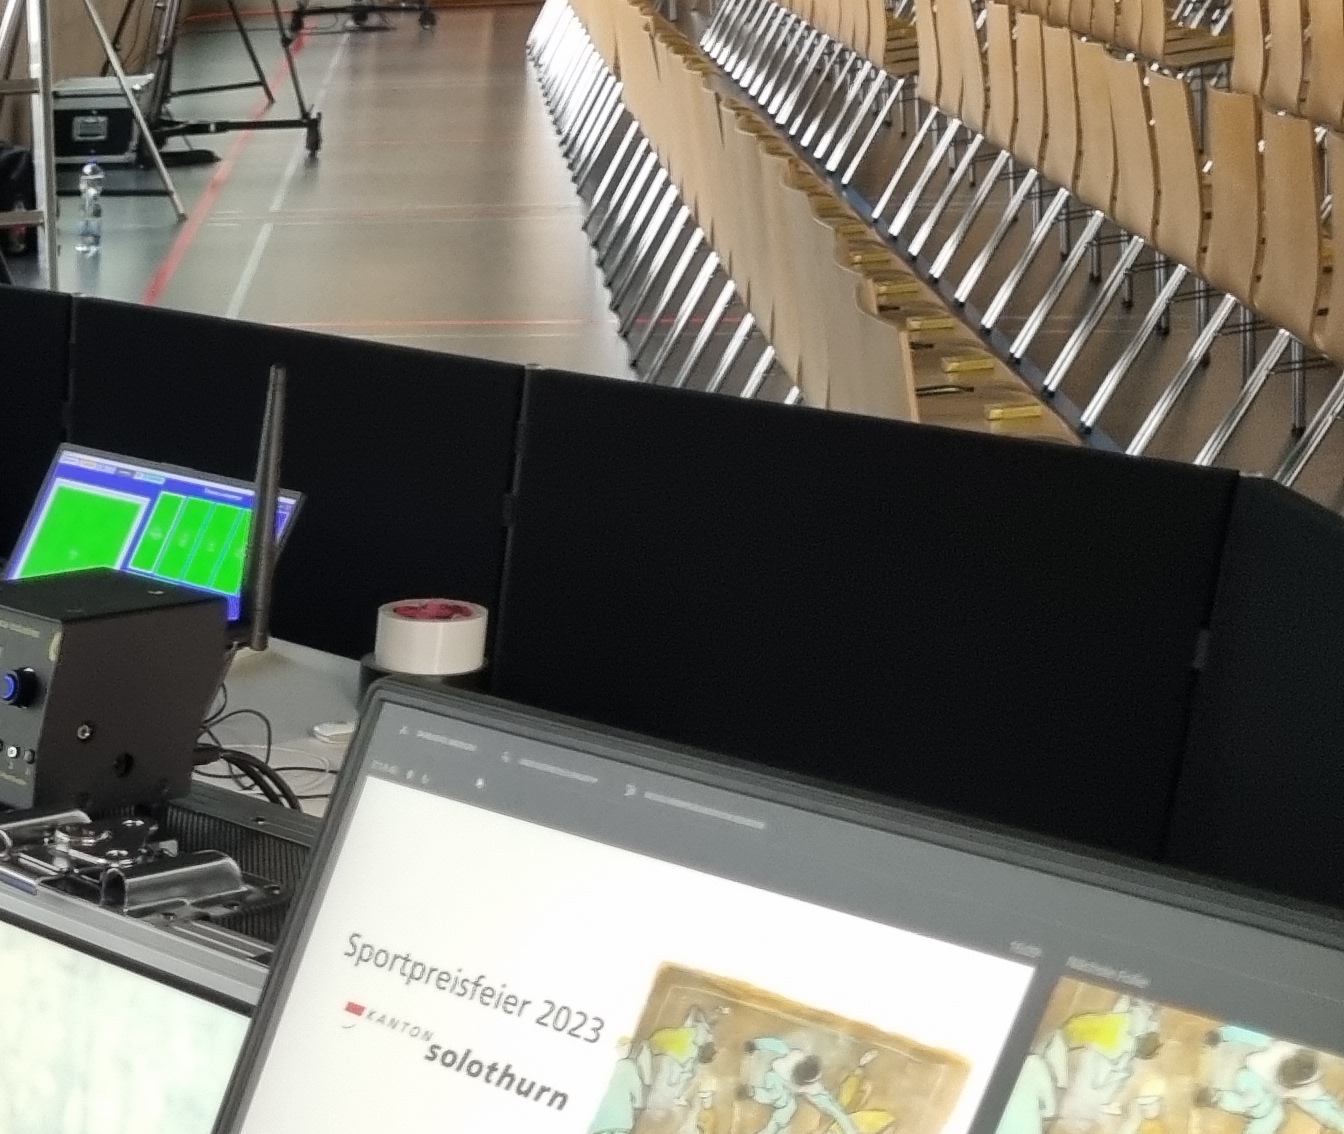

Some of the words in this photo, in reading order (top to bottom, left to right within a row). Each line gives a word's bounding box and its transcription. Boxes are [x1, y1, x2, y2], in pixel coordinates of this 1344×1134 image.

[344, 932, 532, 1018] Sportpreisfeier
[535, 999, 605, 1044] 2023
[366, 1009, 434, 1042] KANTON
[424, 1041, 570, 1112] solothurn
